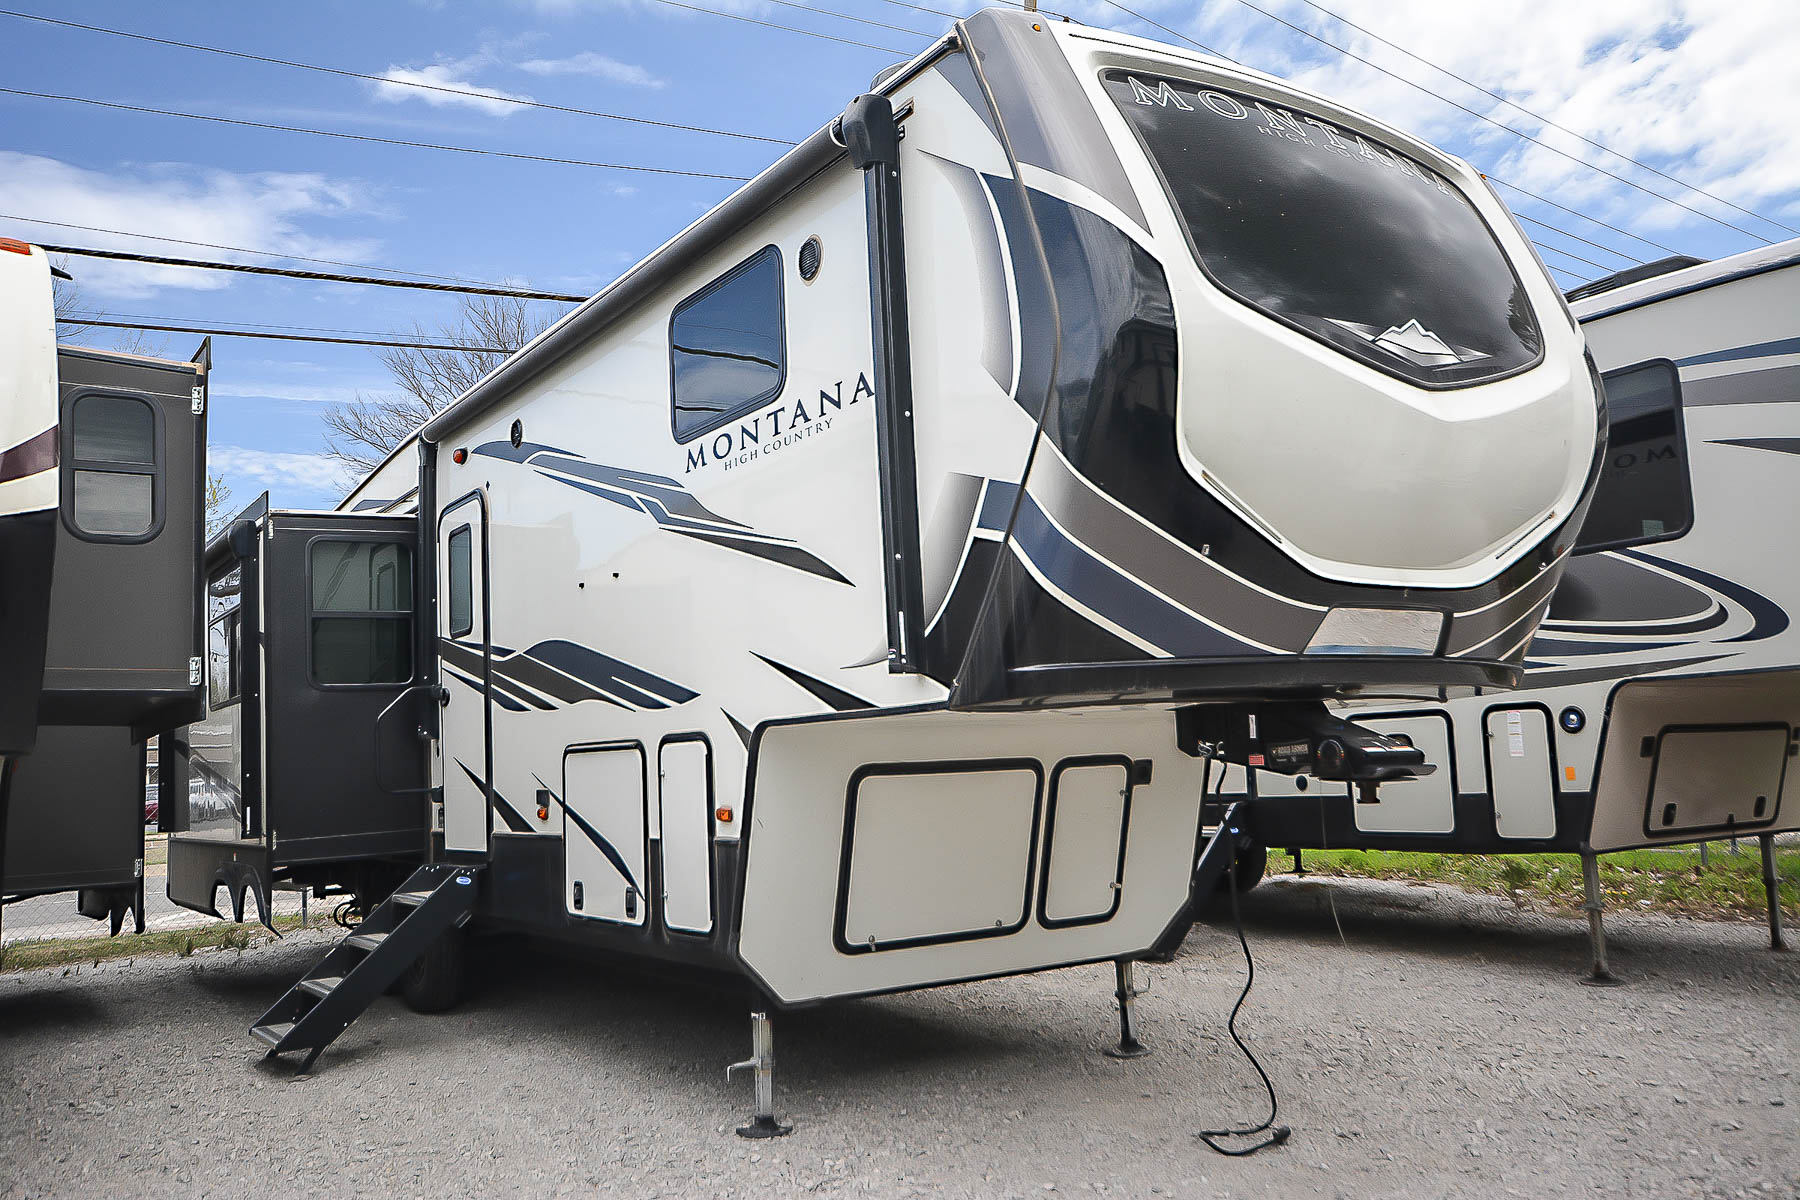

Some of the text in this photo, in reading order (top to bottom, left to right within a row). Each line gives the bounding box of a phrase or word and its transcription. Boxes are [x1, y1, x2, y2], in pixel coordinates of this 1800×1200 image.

[1127, 76, 1465, 204] MONTANA
[1256, 125, 1317, 147] HIGH
[685, 371, 875, 474] MONTANA
[724, 417, 833, 471] HIGH COUNTRY
